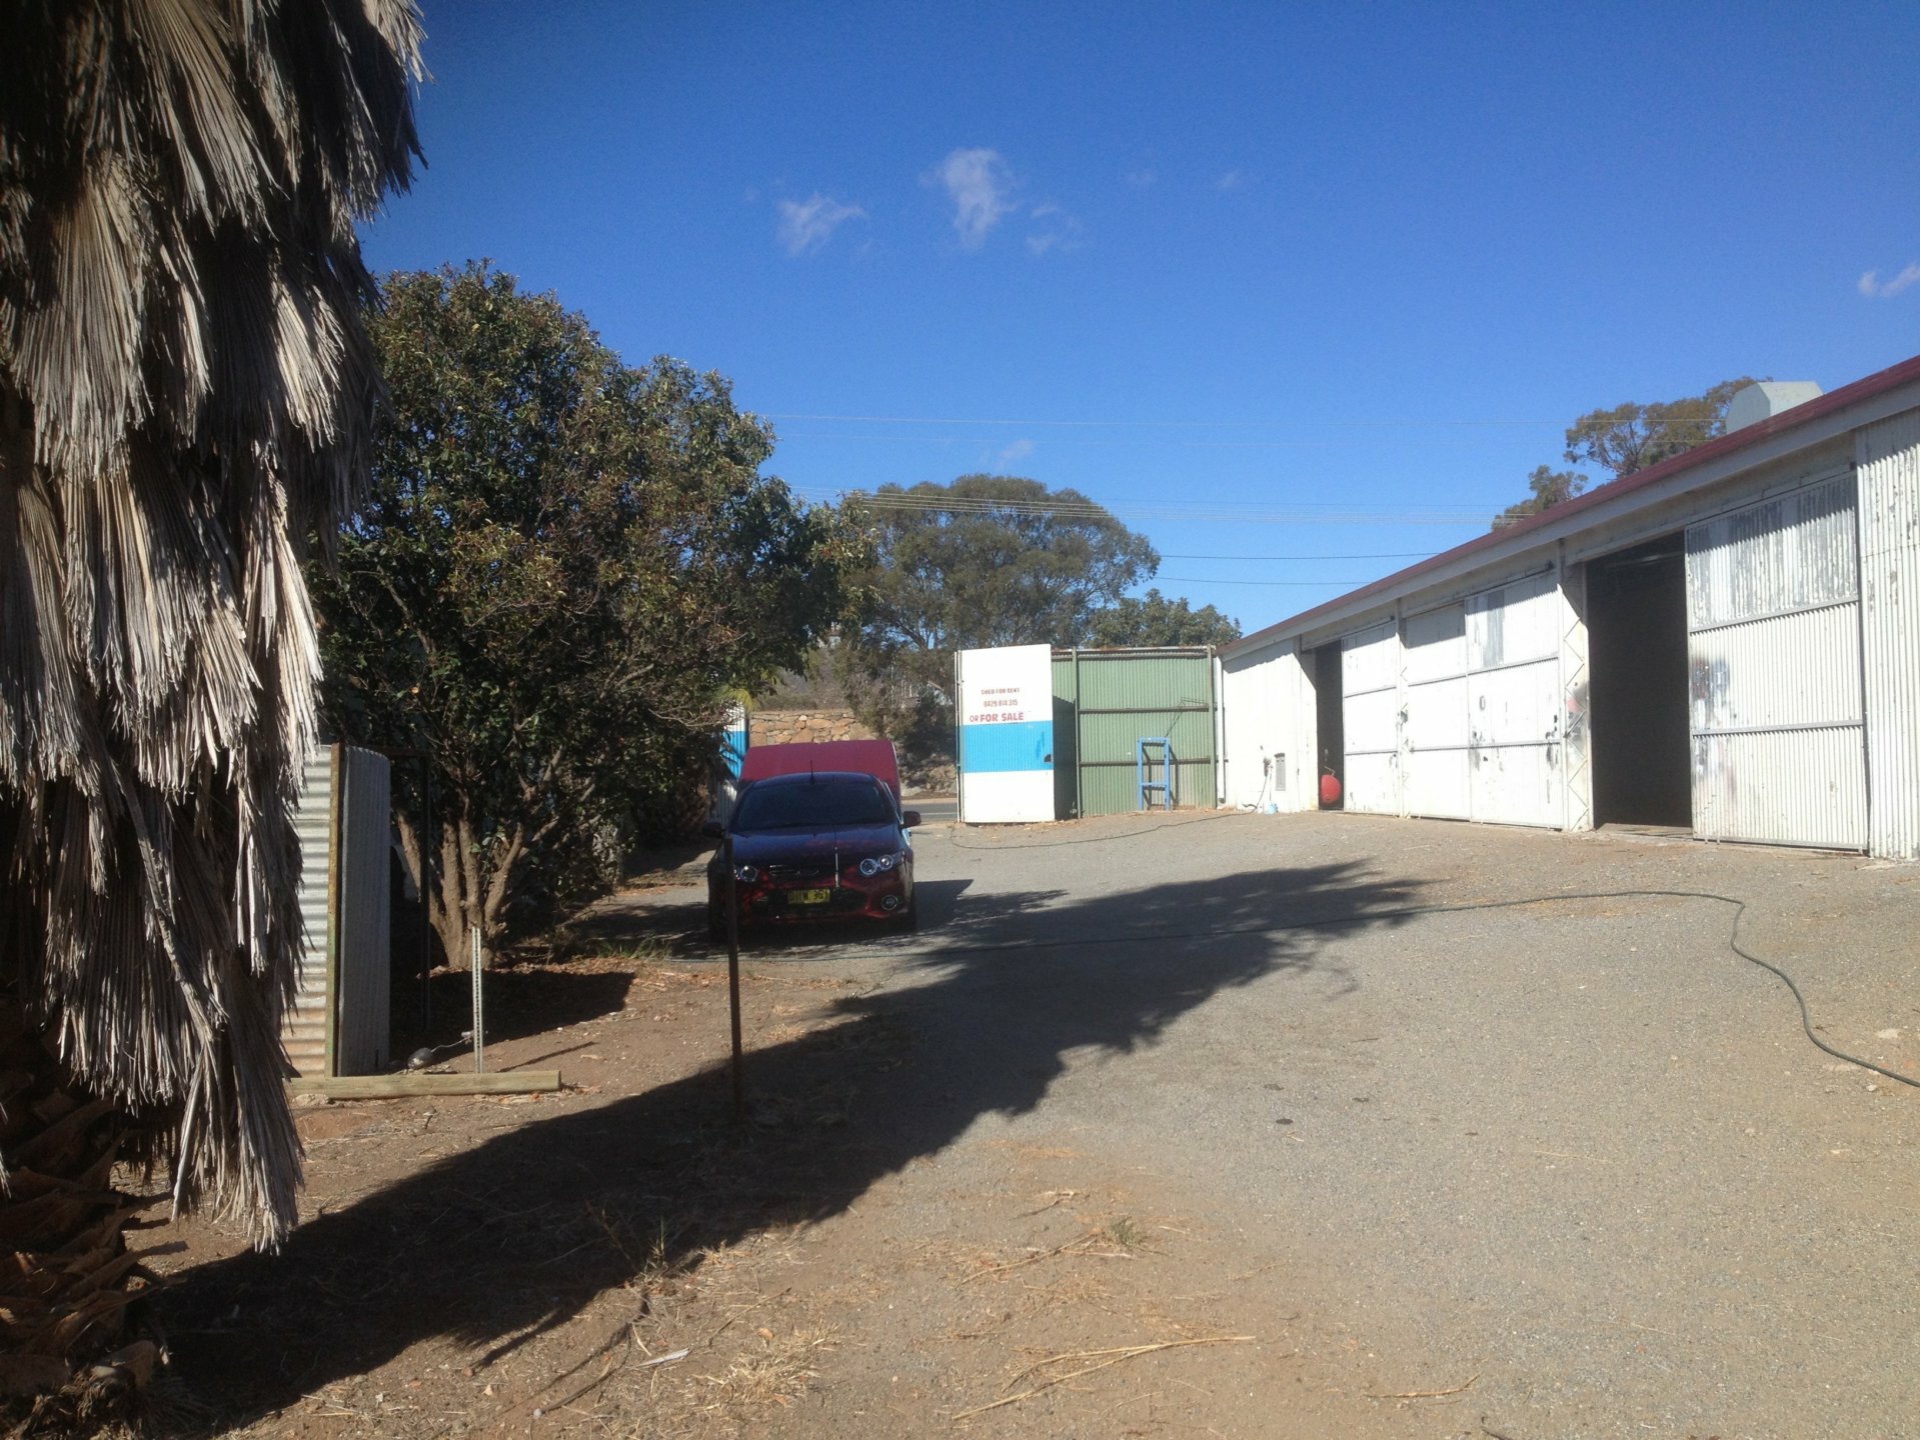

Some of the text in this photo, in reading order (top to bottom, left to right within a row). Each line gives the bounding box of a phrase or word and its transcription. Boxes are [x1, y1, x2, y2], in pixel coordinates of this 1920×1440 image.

[969, 712, 1024, 722] OR FOR SALE
